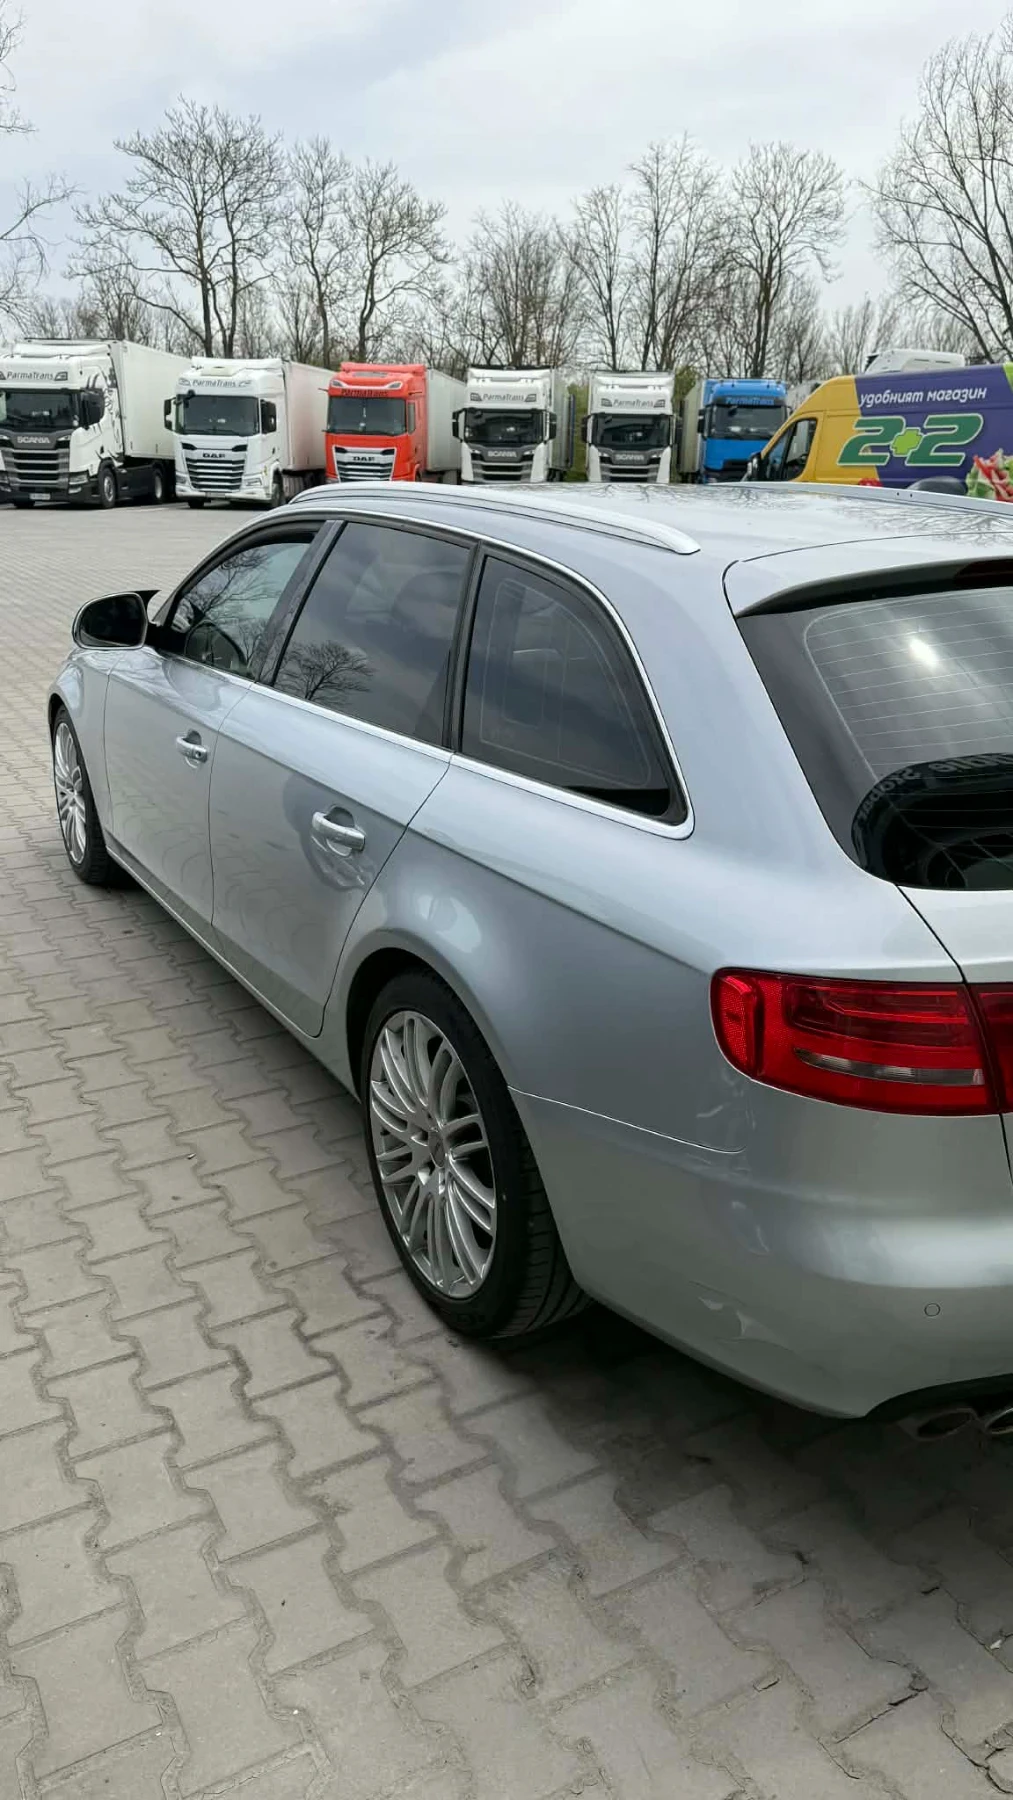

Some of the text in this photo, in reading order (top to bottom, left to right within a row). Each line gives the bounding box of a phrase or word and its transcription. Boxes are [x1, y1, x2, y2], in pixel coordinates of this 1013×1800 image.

[7, 370, 54, 380] ParmaTrans
[193, 379, 236, 388] ParmaTrans
[483, 393, 525, 401] ParmaTrans
[859, 386, 988, 408] удобният магазин
[16, 435, 51, 444] SCANIA
[837, 413, 984, 466] 2+2
[487, 450, 518, 458] SCANIA
